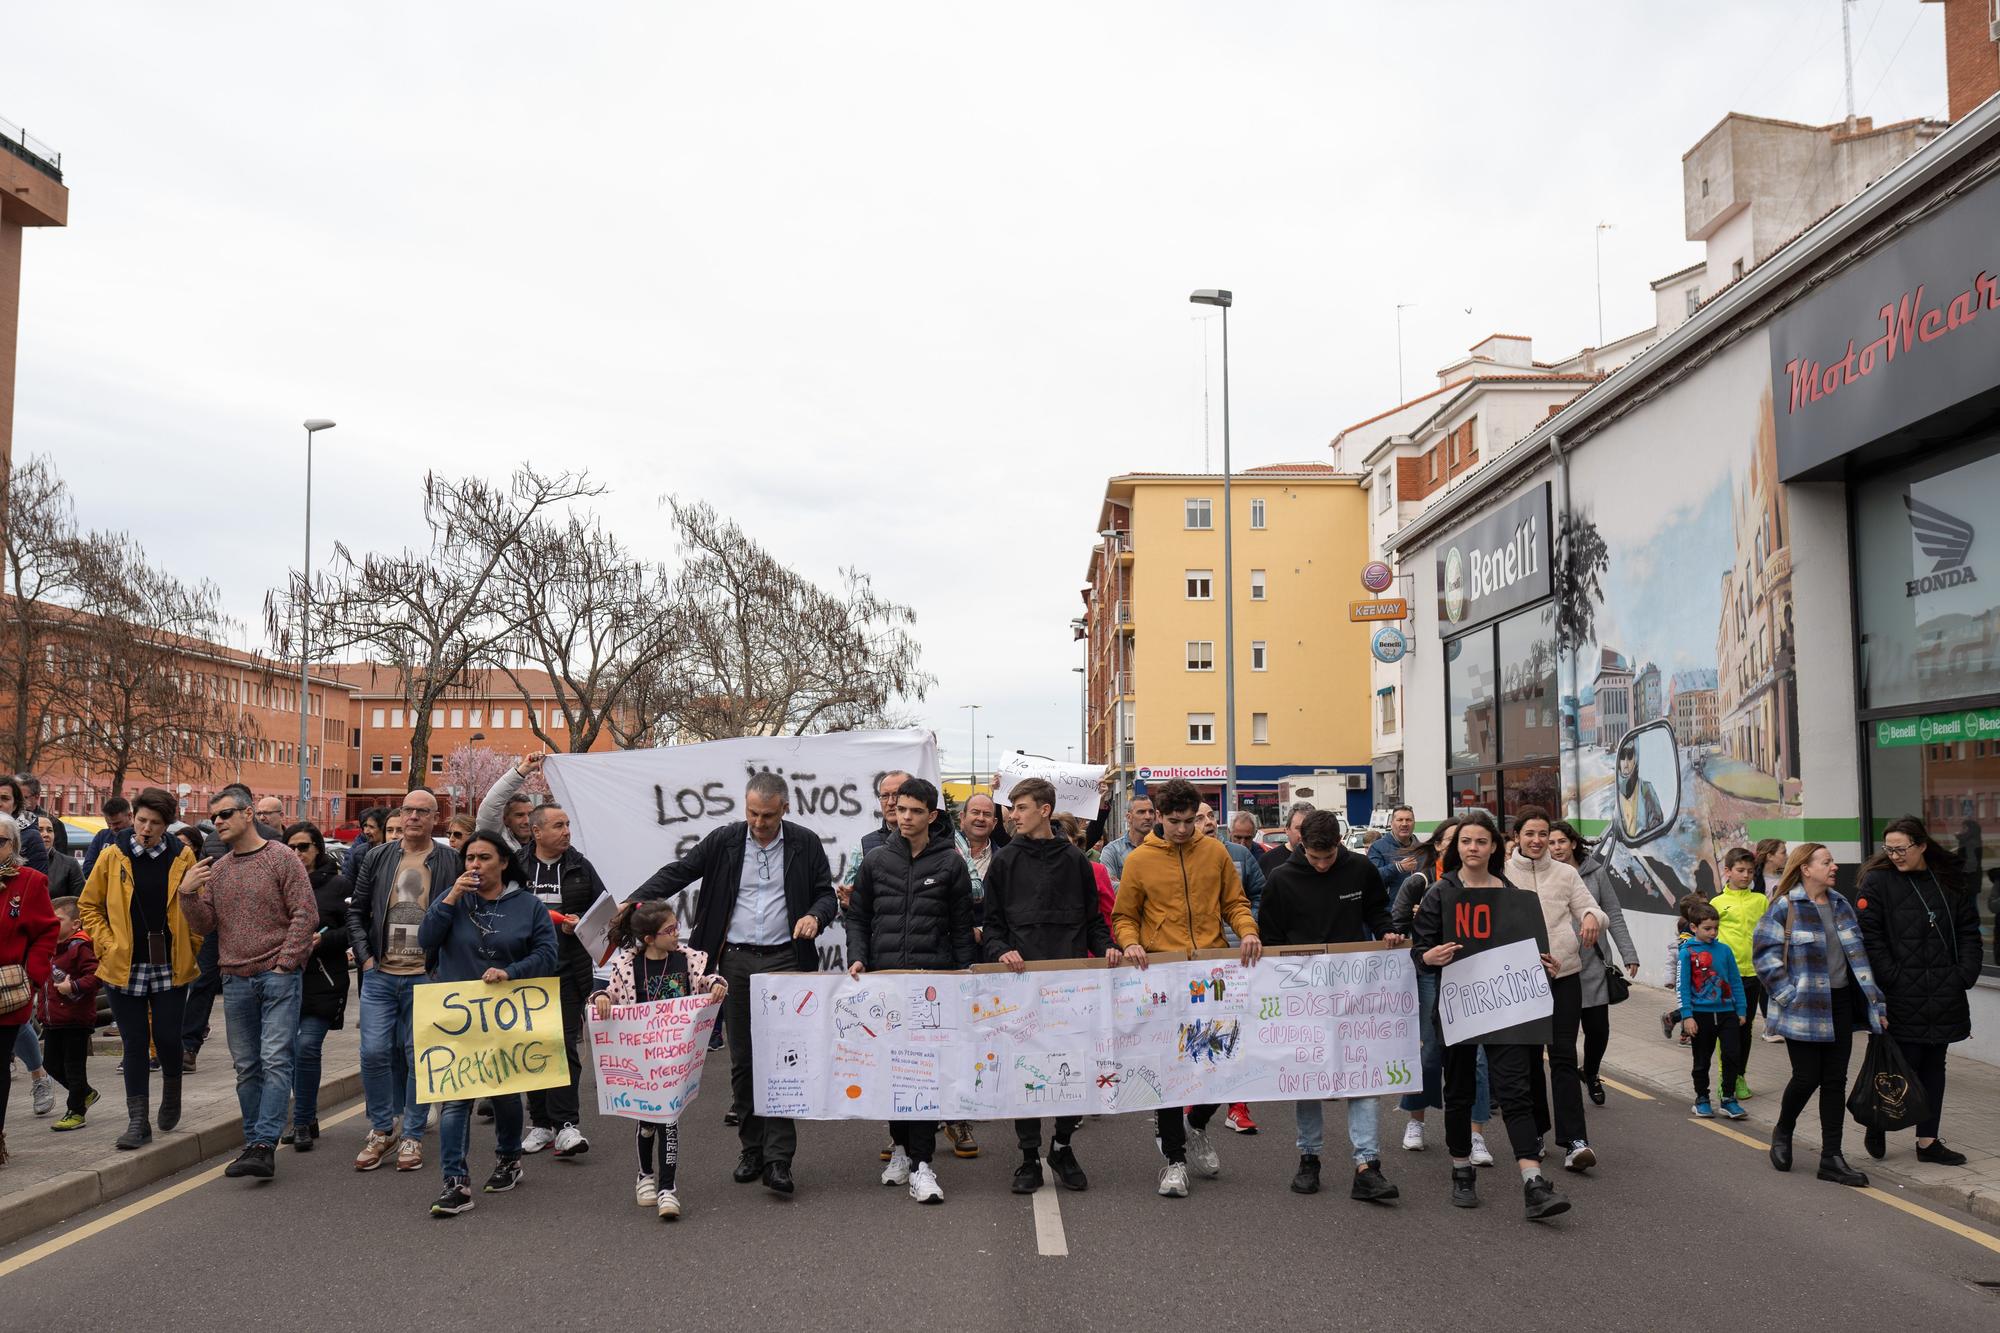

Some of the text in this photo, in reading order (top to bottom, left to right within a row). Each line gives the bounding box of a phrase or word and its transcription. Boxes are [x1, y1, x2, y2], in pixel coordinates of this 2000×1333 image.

[1470, 515, 1538, 601] Benelli
[1906, 565, 1977, 598] HONDA
[1355, 604, 1400, 616] KEEWAY
[1891, 724, 1916, 738] Benelli
[1933, 720, 1960, 735] Benelli
[654, 782, 735, 825] LOS
[1455, 901, 1491, 939] NO
[1274, 953, 1401, 989] ZAMORA
[1287, 986, 1414, 1016] DISTINTIVO
[1441, 964, 1550, 1024] PARKING
[433, 985, 549, 1036] STOP
[612, 1004, 650, 1021] FUTURO
[656, 1000, 675, 1015] SON
[595, 1031, 613, 1045] EL
[620, 1028, 684, 1046] PRESENTE
[1258, 1016, 1407, 1044] CIUDAD AMIGA
[420, 1041, 552, 1095] PARKING
[600, 1055, 638, 1072] ELLOS
[1296, 1045, 1367, 1063] DE LA
[605, 1076, 658, 1091] ESPACIO
[1279, 1064, 1383, 1093] INFANCIA
